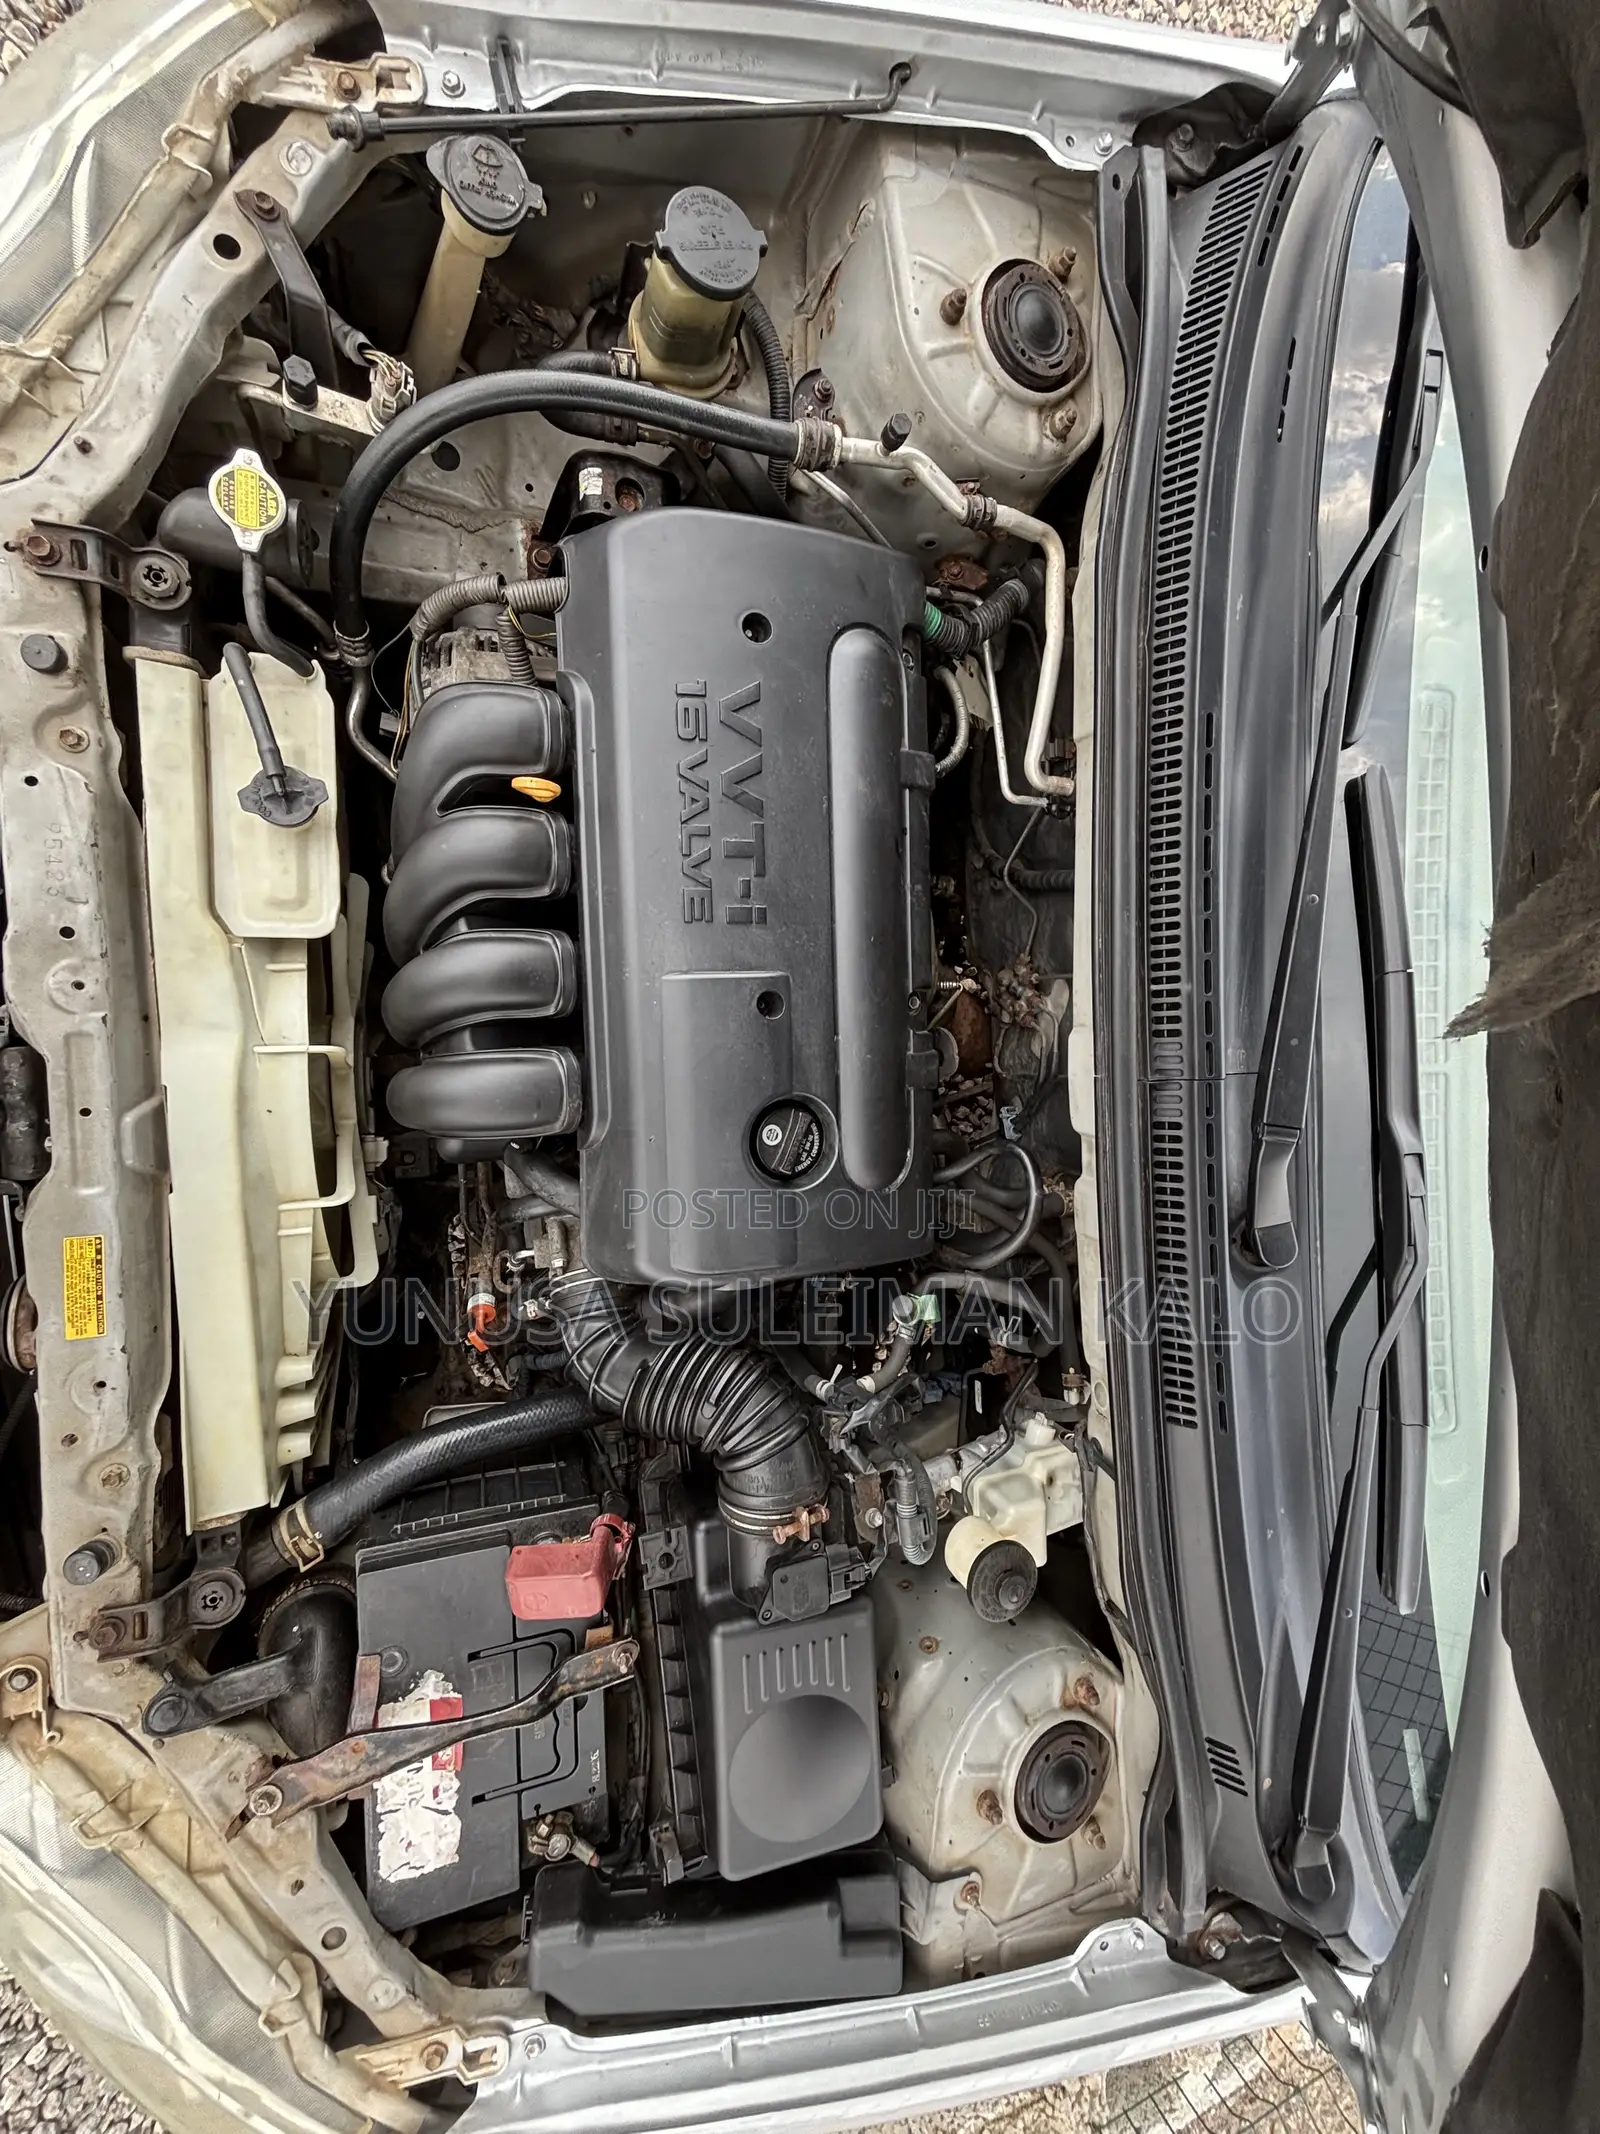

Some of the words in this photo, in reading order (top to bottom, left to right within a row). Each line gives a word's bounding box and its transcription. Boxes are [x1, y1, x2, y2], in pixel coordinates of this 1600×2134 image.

[259, 481, 268, 523] CAUTION
[675, 678, 708, 741] 16
[719, 680, 767, 924] VVT-i
[677, 747, 713, 923] VALVE
[795, 1157, 813, 1172] ENERGY
[810, 1122, 820, 1157] CONSERVING
[800, 1151, 808, 1161] SAE
